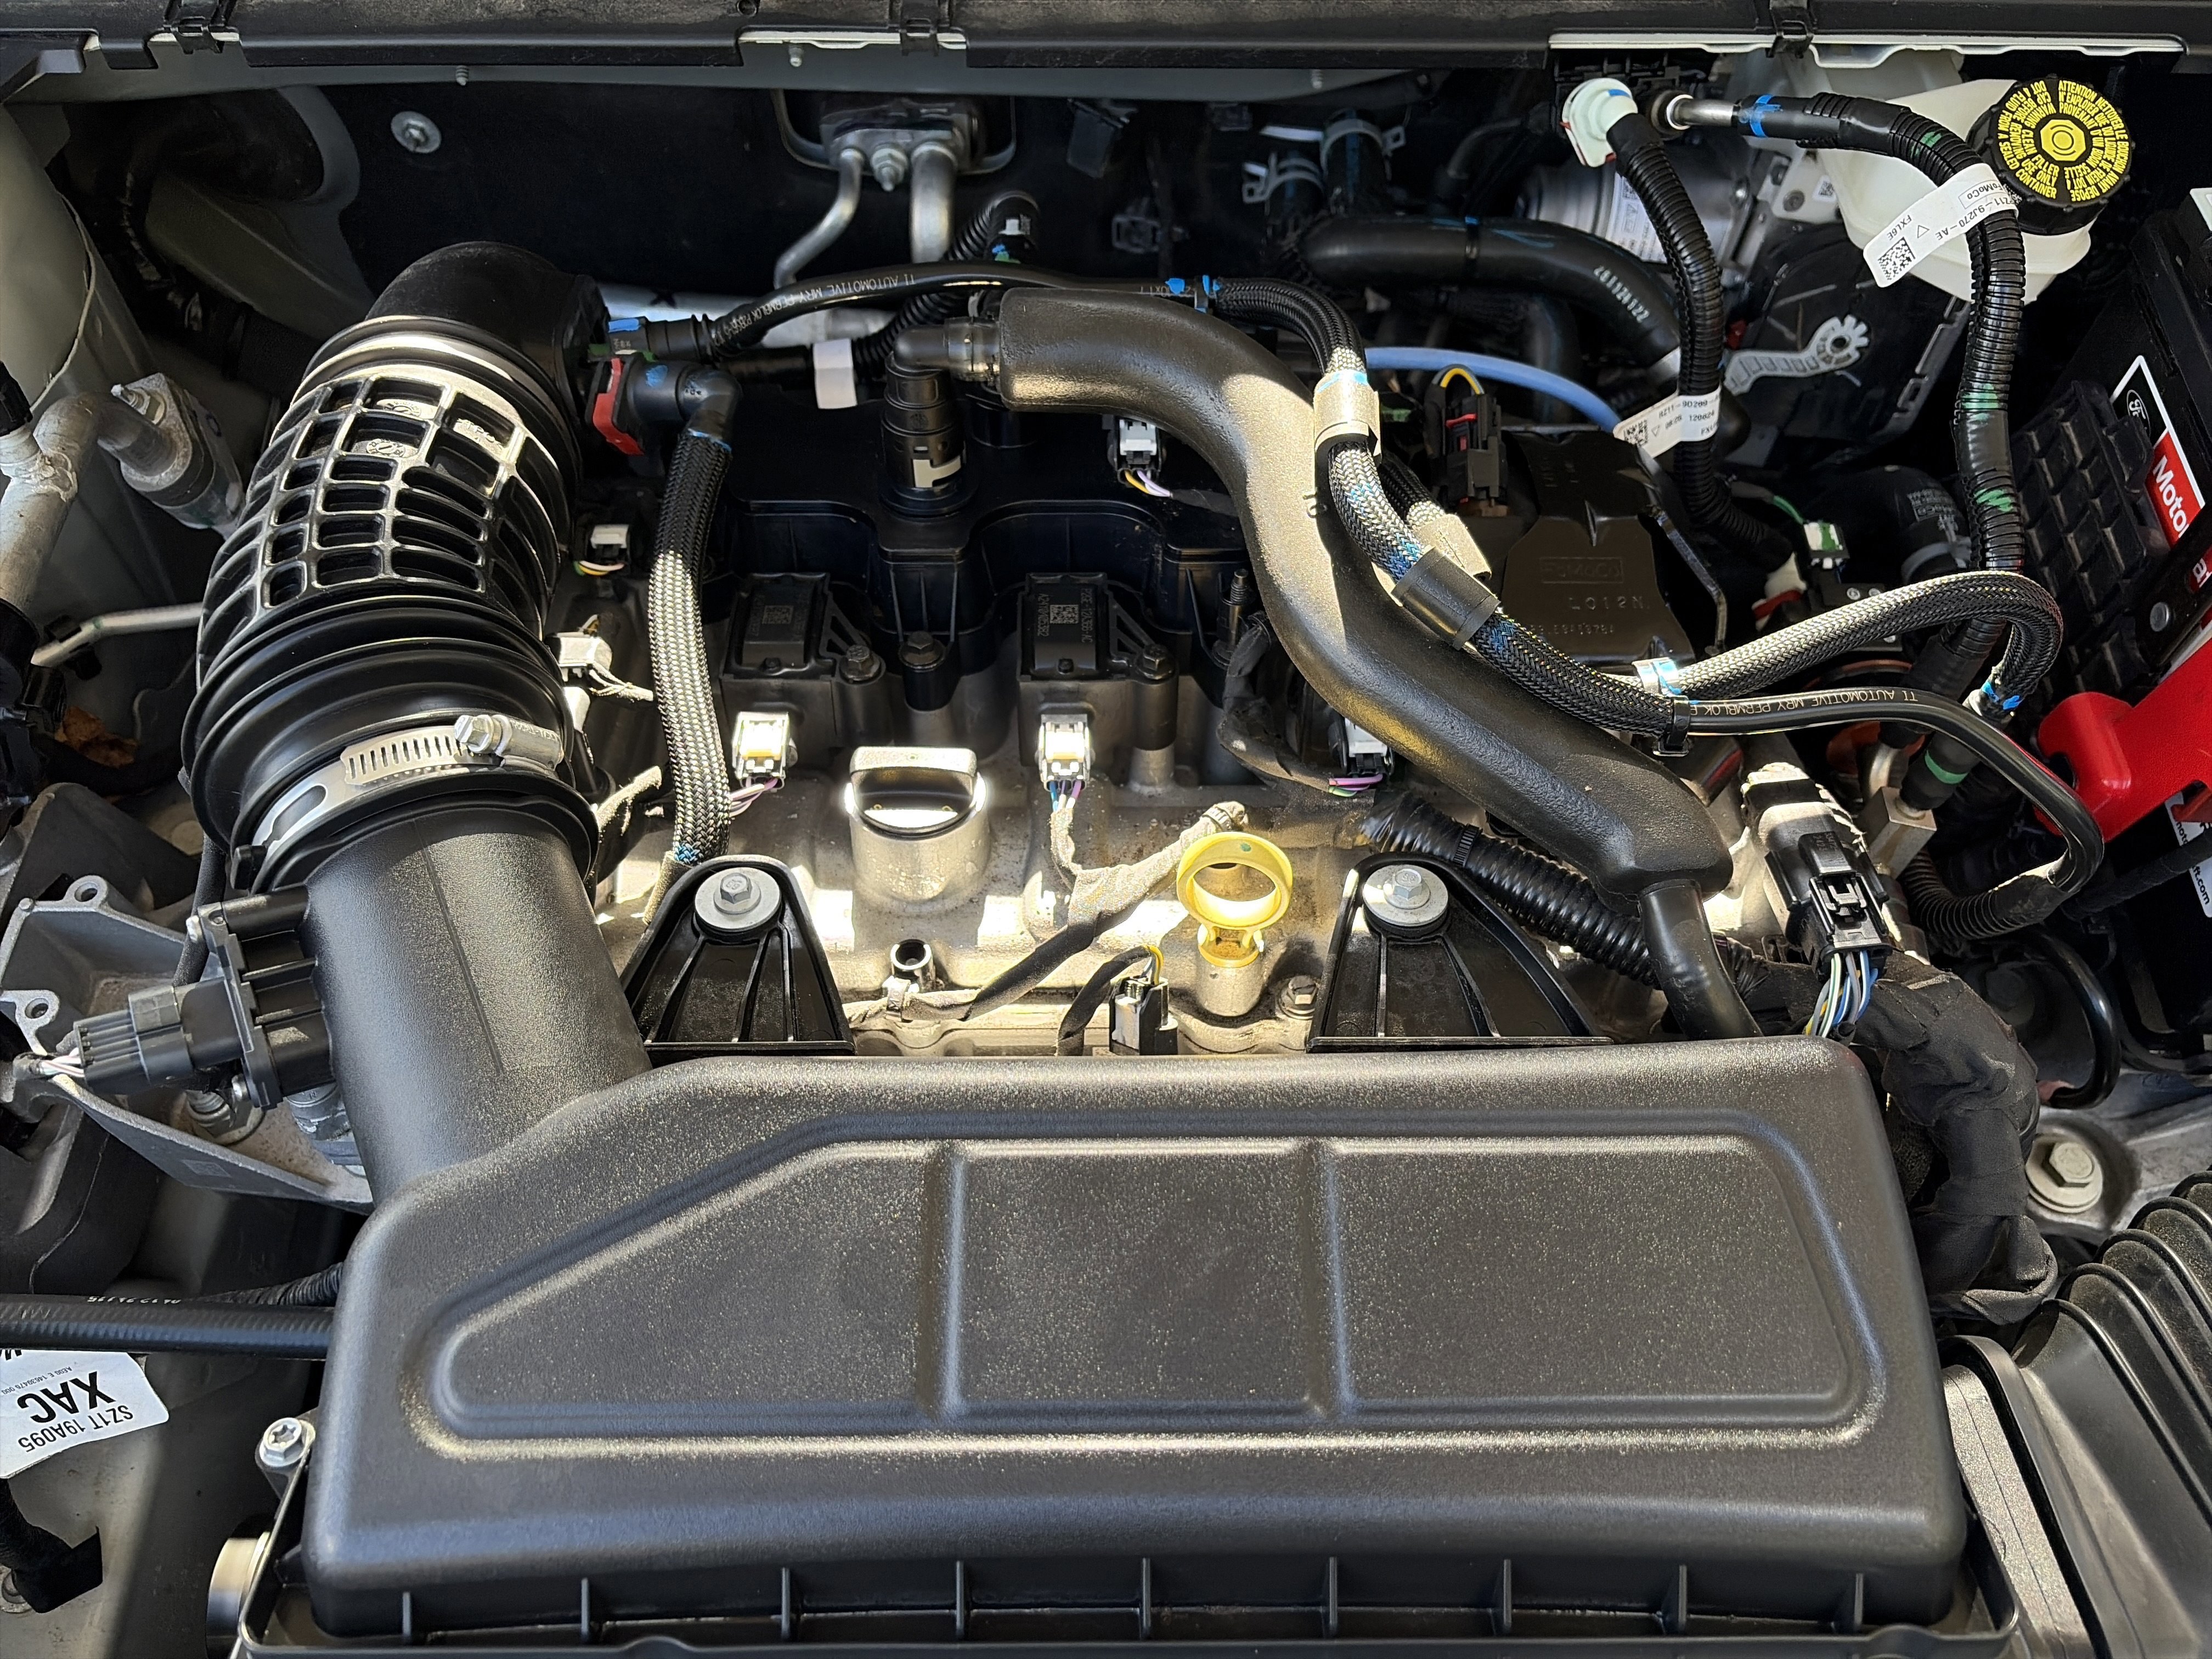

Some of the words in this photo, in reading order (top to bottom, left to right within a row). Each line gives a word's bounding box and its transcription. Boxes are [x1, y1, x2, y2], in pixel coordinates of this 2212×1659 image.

[2023, 88, 2031, 97] 4
[2030, 81, 2047, 92] DOT
[2058, 80, 2097, 101] ATTENTION
[2006, 91, 2025, 111] FLUID
[2037, 92, 2051, 103] CAP
[1998, 110, 2012, 131] FROM
[2013, 98, 2036, 123] BEFORE
[2024, 102, 2056, 128] WARNING
[2059, 102, 2098, 129] PROVENANT
[2095, 113, 2109, 125] QUE
[2097, 97, 2124, 128] NETTOYER
[2010, 122, 2027, 159] REMOVING
[2102, 126, 2114, 137] DU
[2115, 127, 2128, 139] LE
[2022, 129, 2038, 155] CLEAN
[2103, 137, 2117, 159] LIQUIDE
[1999, 142, 2019, 170] SEALED
[2032, 154, 2059, 177] FILLER
[2087, 149, 2103, 168] BIDON
[2100, 159, 2112, 171] DE
[2113, 141, 2129, 176] BOUCHON
[2022, 158, 2038, 176] USE
[2064, 165, 2091, 179] SCELLE
[2086, 167, 2106, 182] FREIN
[2016, 168, 2057, 199] CONTAINER
[2036, 170, 2057, 187] ONLY
[2066, 179, 2071, 190] 4
[2073, 178, 2087, 188] DOT
[2098, 172, 2119, 193] AVANT
[1965, 183, 2003, 200] FoMoCo
[2070, 189, 2100, 202] DEPOSE
[1887, 214, 1913, 240] FXL6E
[827, 275, 899, 295] AUTOMOTIVE
[1777, 698, 1805, 711] MRY
[1811, 689, 1895, 708] AUTOMOTIVE
[1903, 690, 1918, 702] TI
[16, 1370, 117, 1424] XAC
[87, 1404, 134, 1430] SZ1T
[18, 1419, 87, 1453] 19A095
